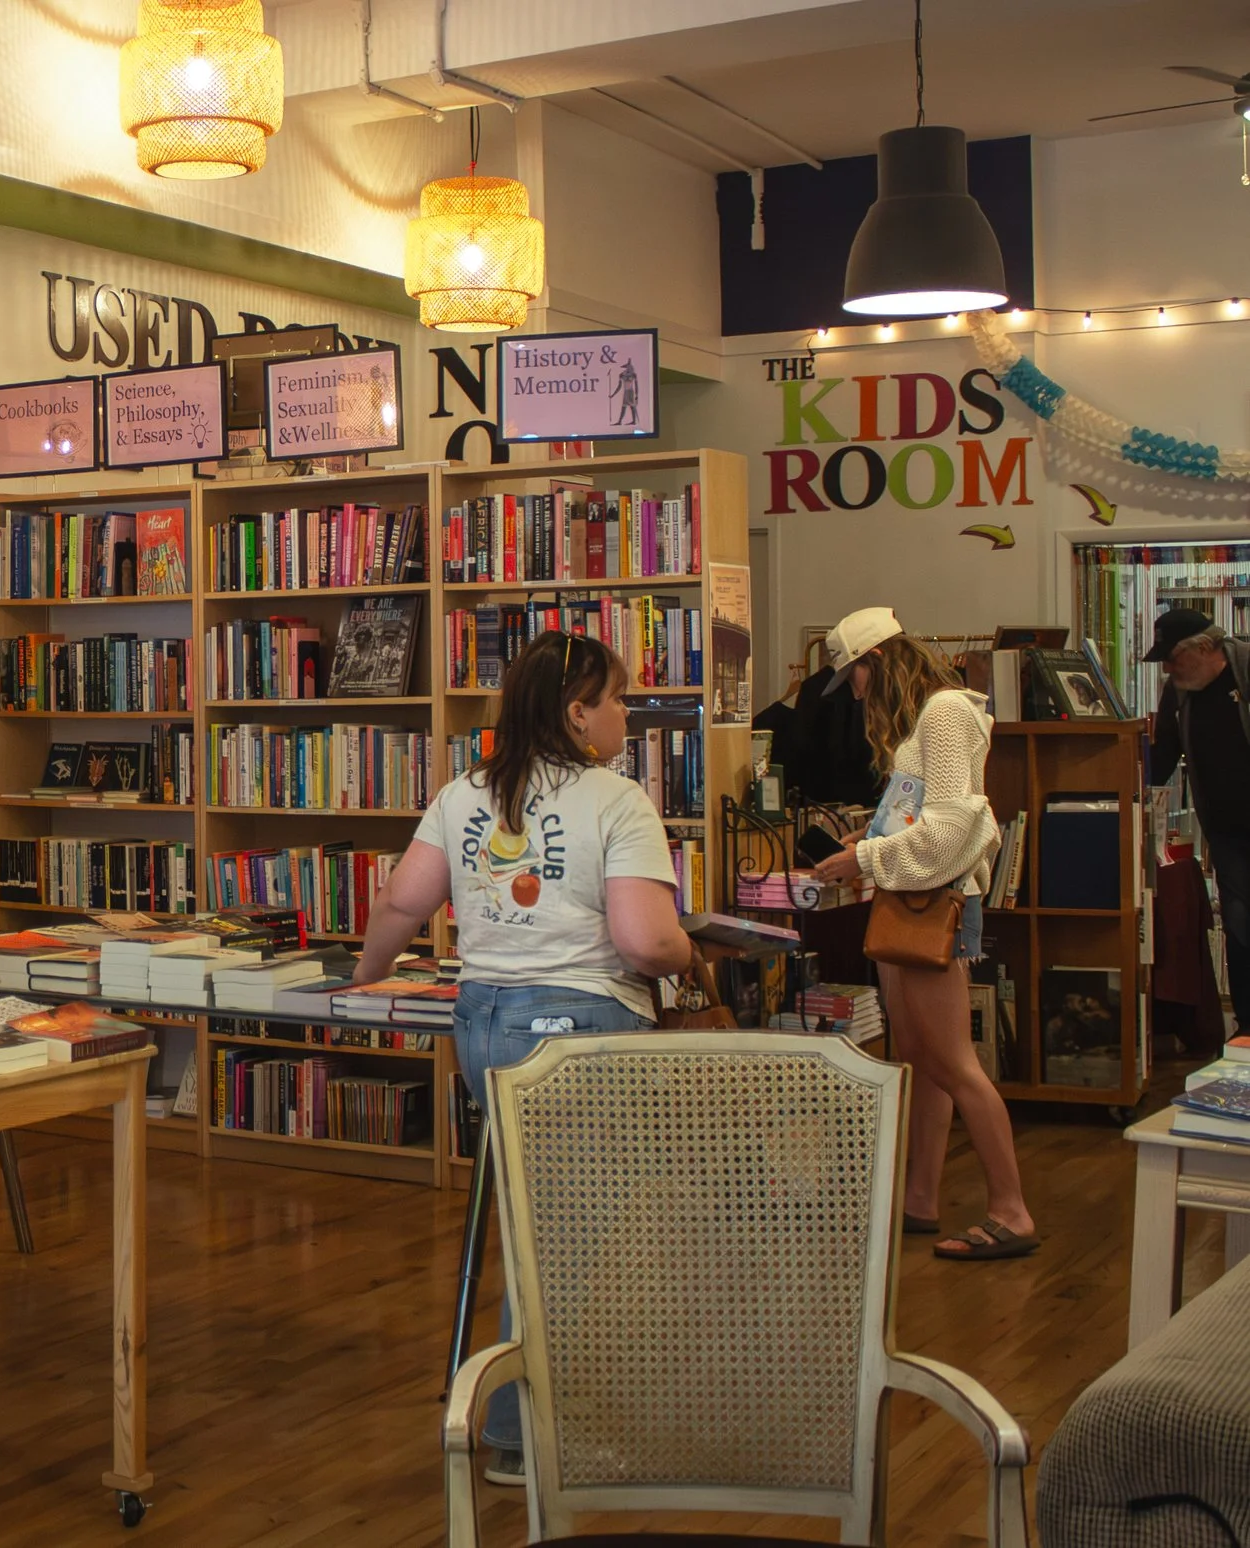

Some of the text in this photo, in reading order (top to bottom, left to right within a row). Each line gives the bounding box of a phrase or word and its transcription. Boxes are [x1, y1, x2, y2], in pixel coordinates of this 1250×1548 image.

[41, 271, 219, 372] USED
[513, 345, 618, 371] History &
[762, 356, 816, 382] THE
[115, 384, 176, 401] Science,
[513, 374, 599, 396] Memoir
[115, 403, 205, 424] Philosophy,
[775, 368, 1006, 445] KIDS
[116, 428, 183, 445] & Essays
[763, 437, 1035, 515] ROOM
[476, 500, 486, 548] AFRICA
[374, 548, 382, 568] CARE
[386, 524, 400, 568] DEEP CARE
[350, 610, 403, 622] EVERYWHERE
[364, 598, 394, 609] WE ARE
[462, 808, 491, 872] JOIN
[541, 813, 566, 881] CLUB
